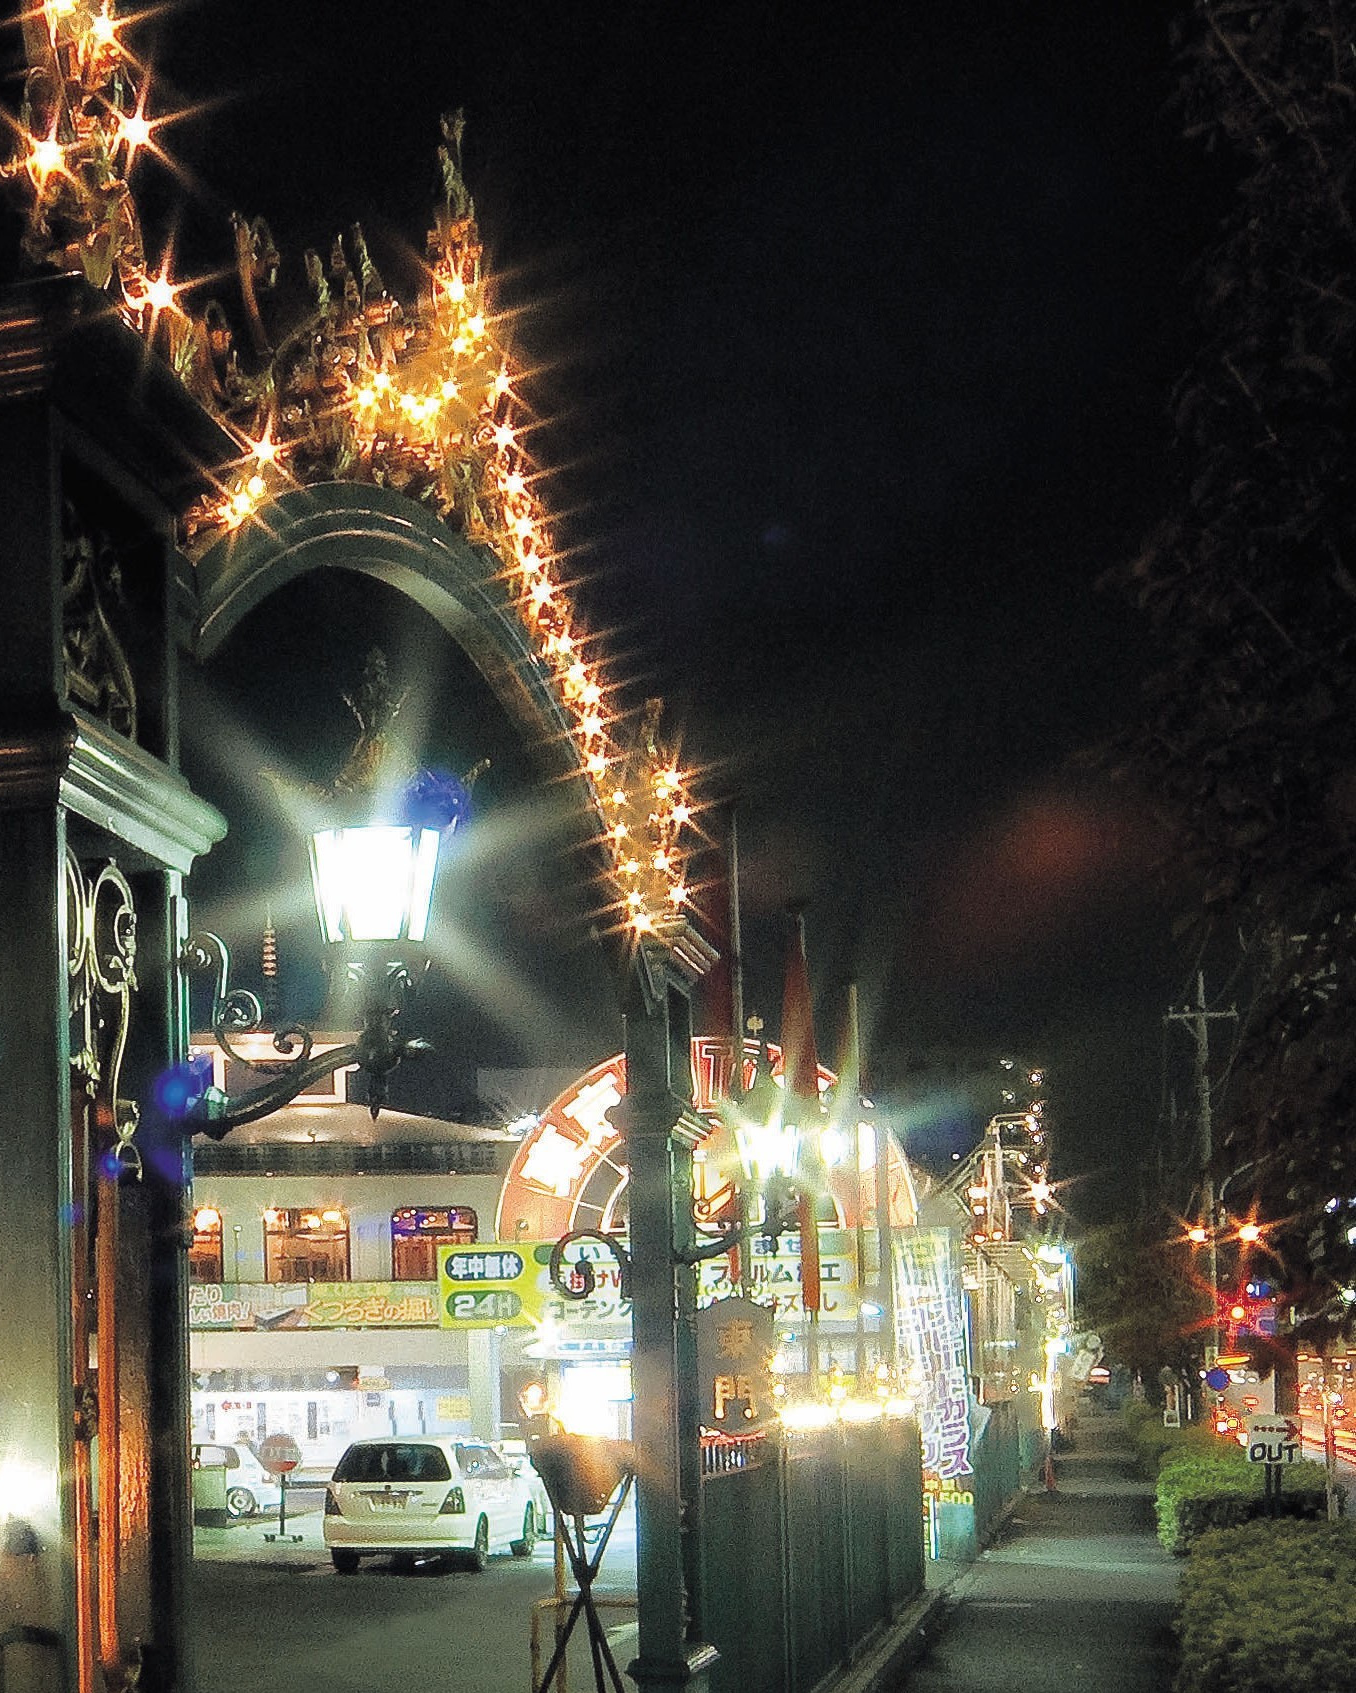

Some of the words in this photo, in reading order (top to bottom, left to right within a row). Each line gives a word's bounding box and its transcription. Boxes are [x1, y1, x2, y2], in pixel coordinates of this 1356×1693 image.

[451, 1254, 519, 1280] 年中無休
[454, 1293, 514, 1318] 24H
[1250, 1442, 1299, 1463] OUT
